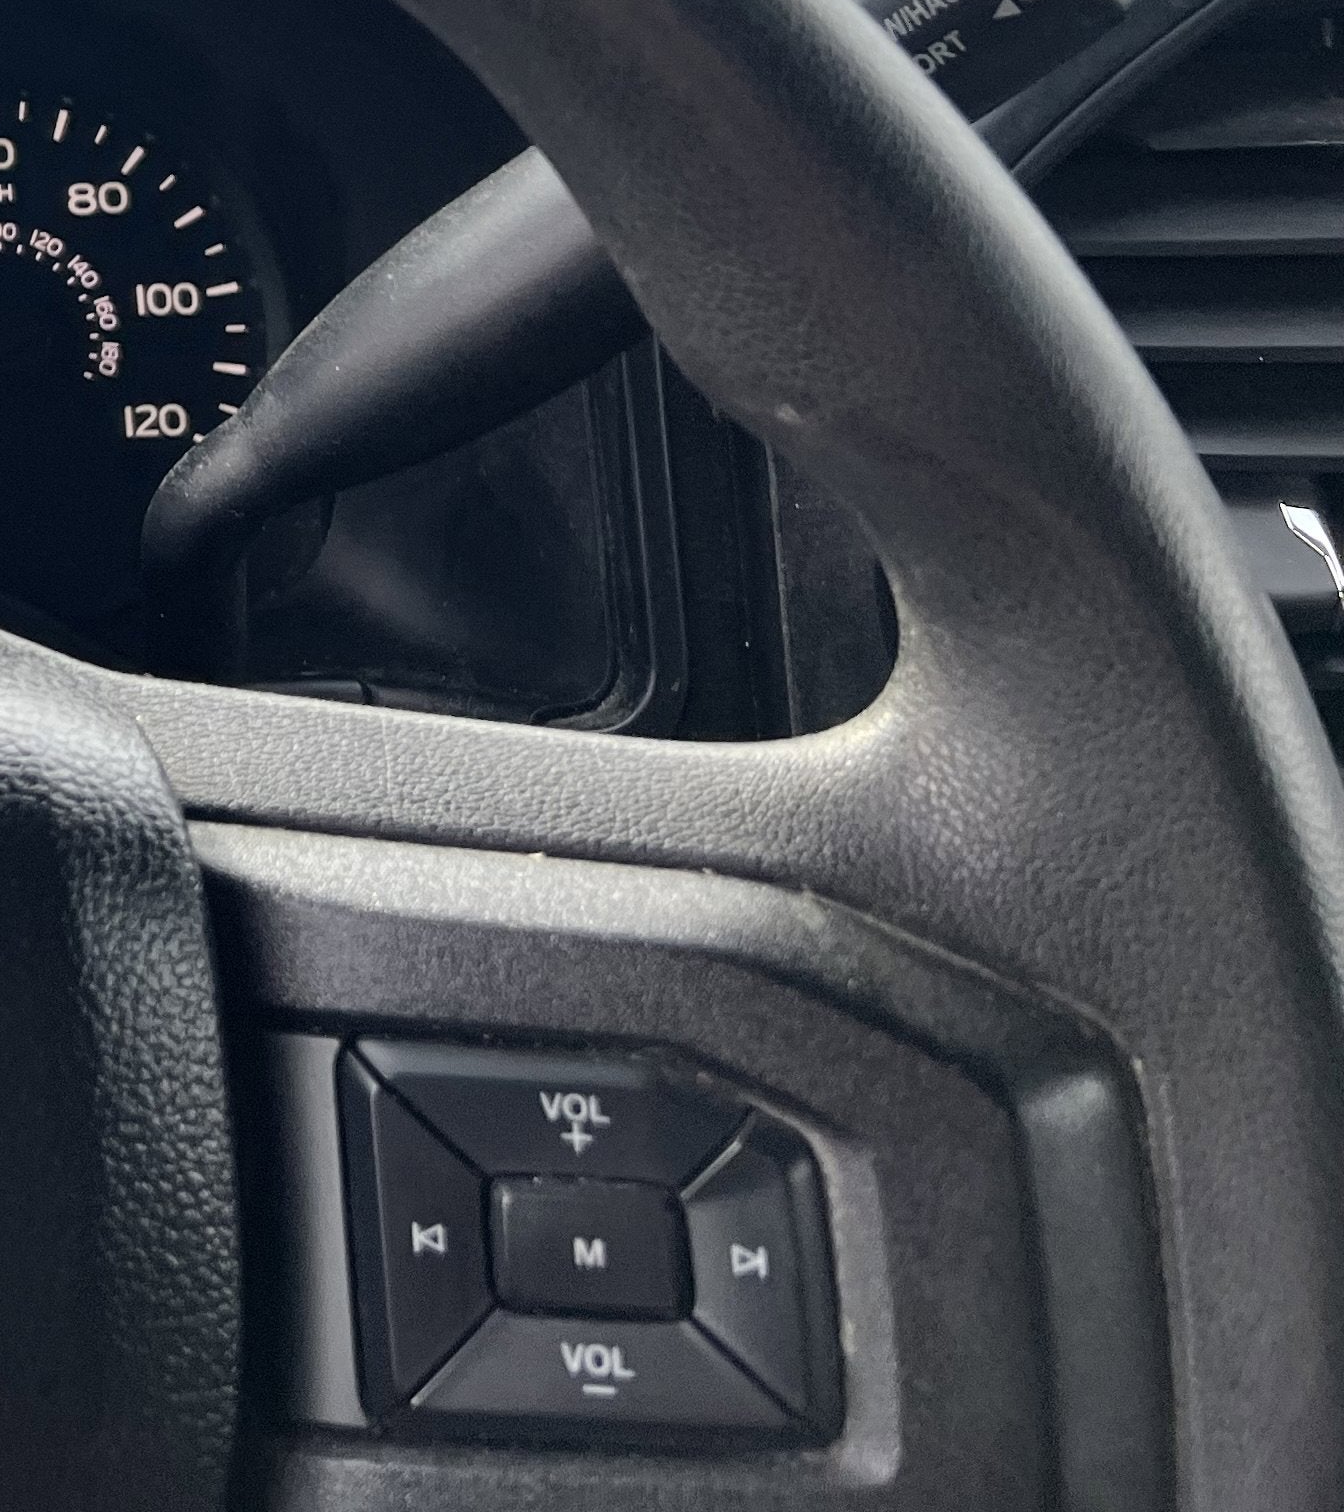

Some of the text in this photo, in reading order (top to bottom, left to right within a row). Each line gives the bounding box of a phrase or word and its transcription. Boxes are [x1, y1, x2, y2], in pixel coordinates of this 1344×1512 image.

[67, 181, 129, 216] 80
[29, 228, 64, 259] 120
[66, 254, 100, 289] 140
[94, 296, 117, 330] 160
[135, 282, 199, 316] 100
[98, 342, 120, 376] 180
[124, 403, 188, 438] 120
[541, 1092, 610, 1125] VOL
[574, 1238, 606, 1268] M
[561, 1343, 635, 1379] VOL
